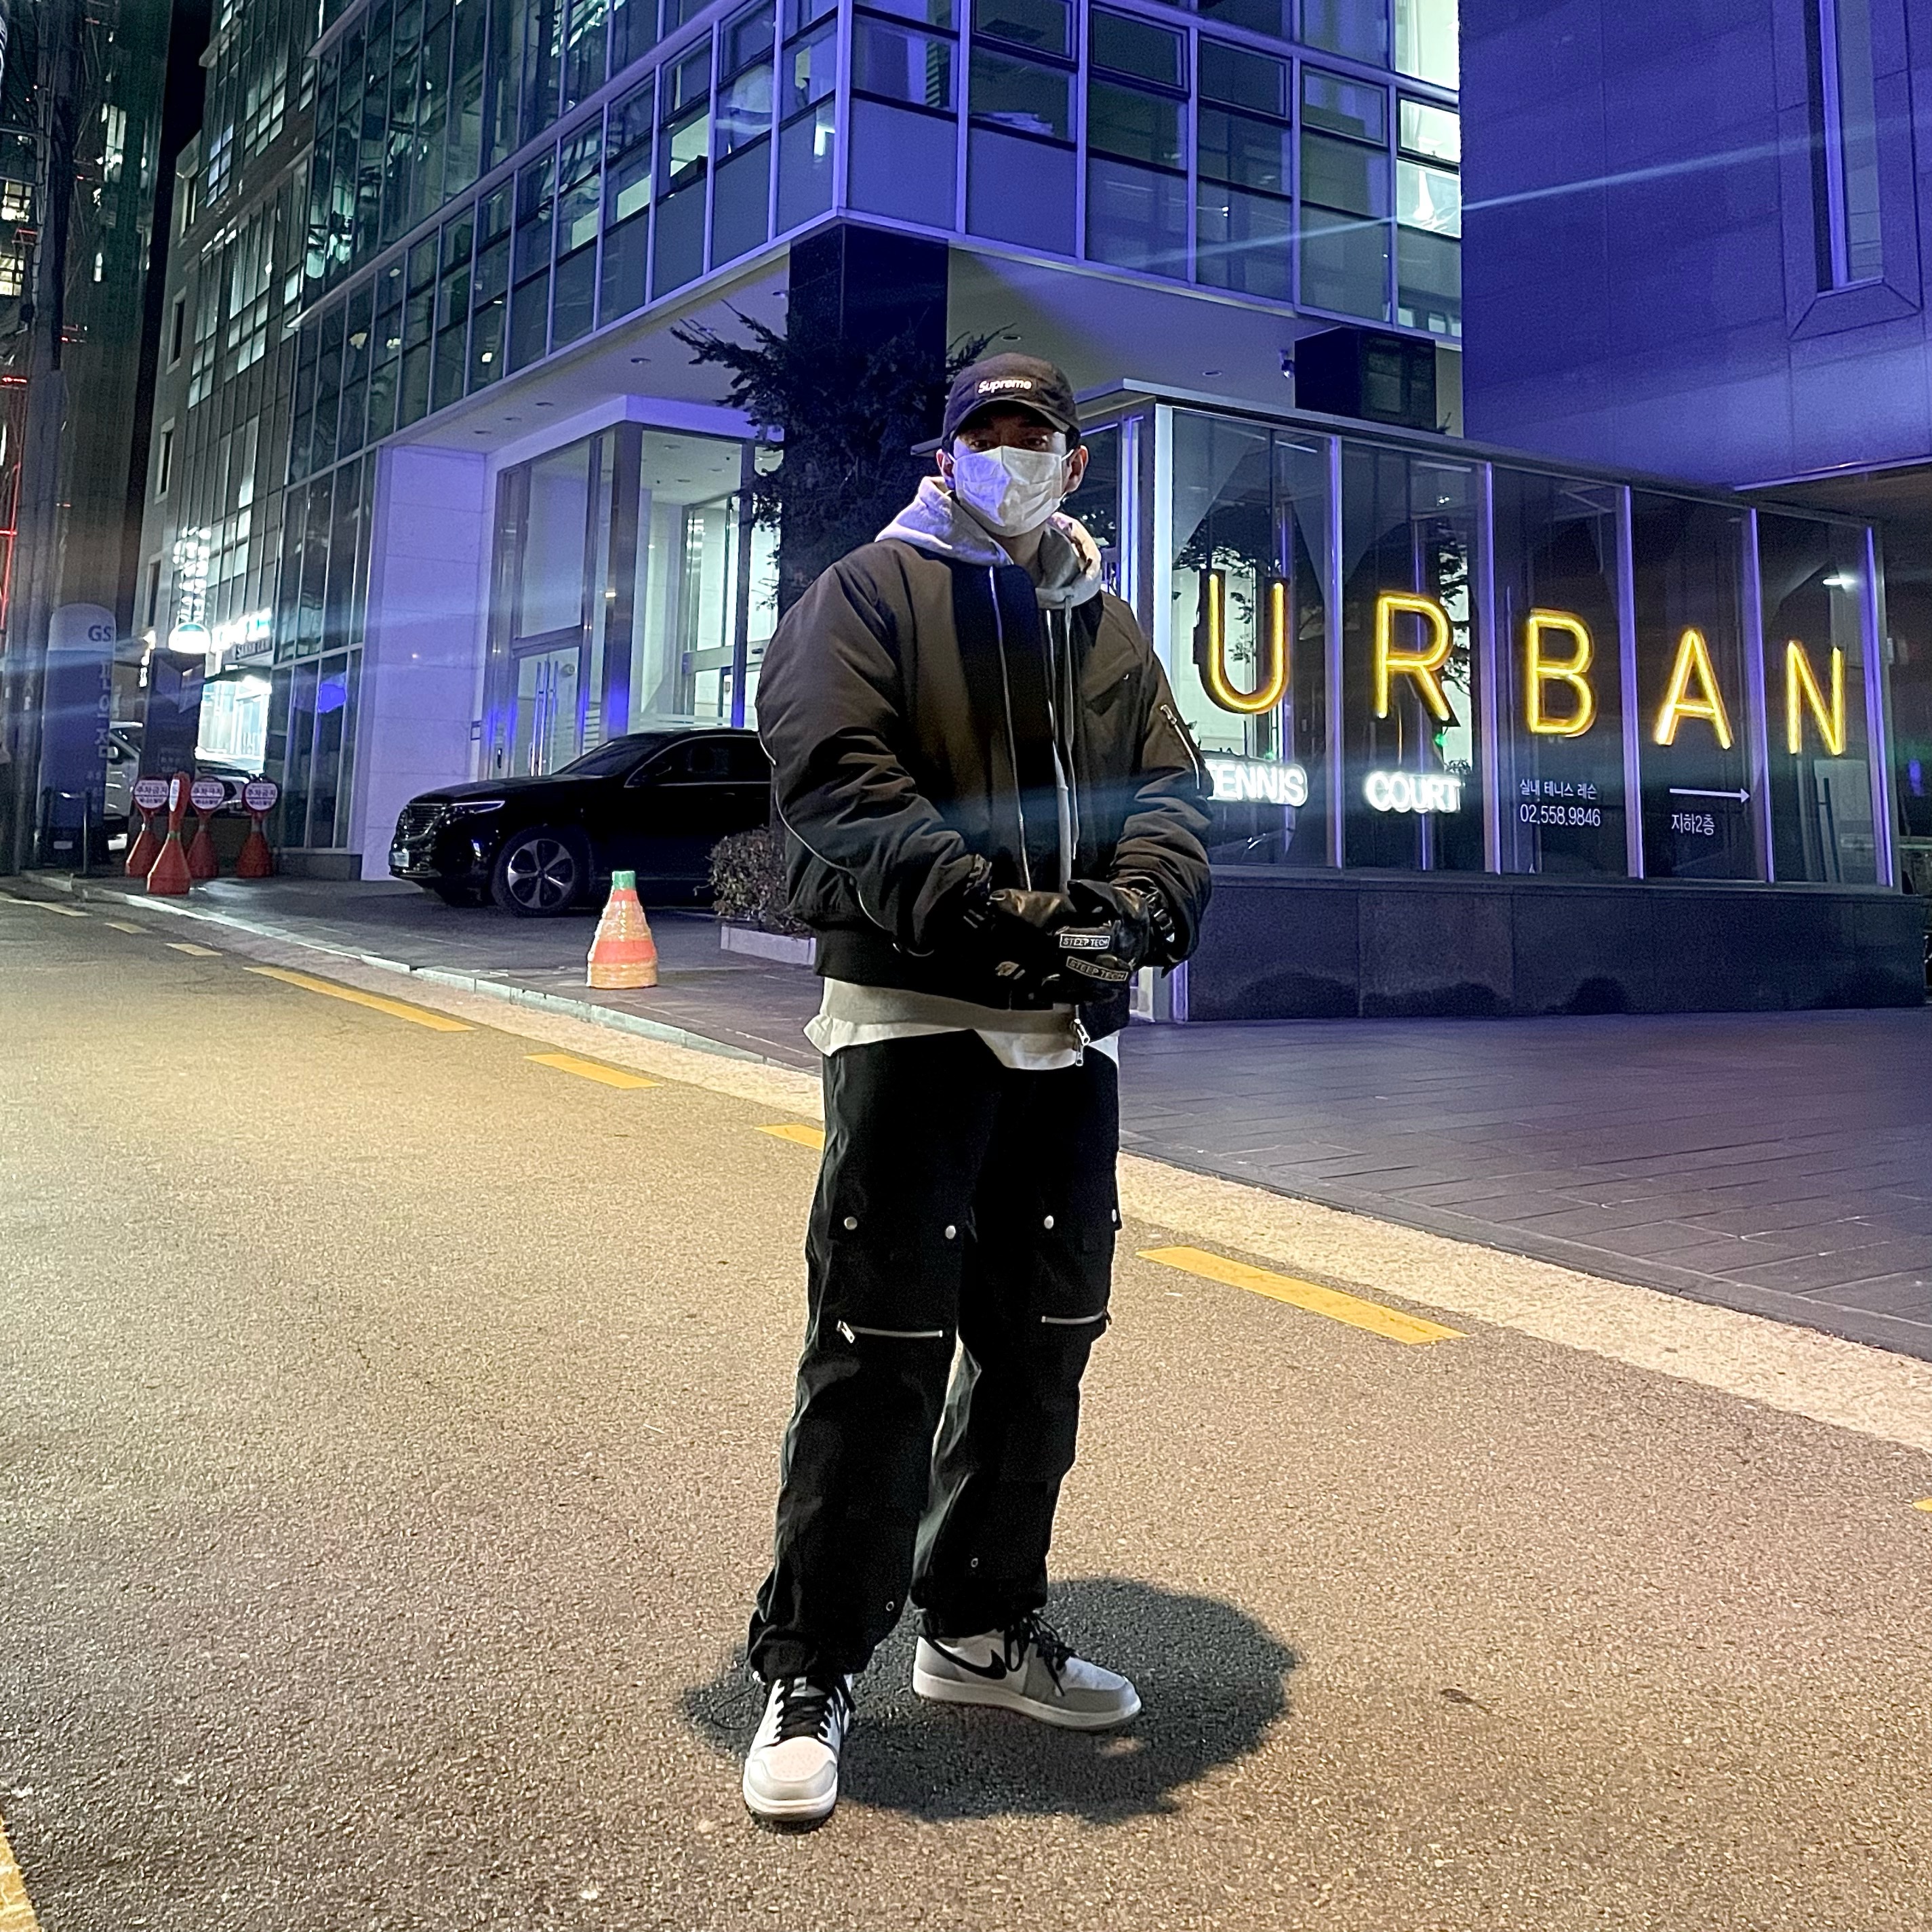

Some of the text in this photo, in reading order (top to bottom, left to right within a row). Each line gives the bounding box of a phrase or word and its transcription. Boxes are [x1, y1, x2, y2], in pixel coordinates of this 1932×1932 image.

[978, 379, 1032, 394] Supreme
[1201, 571, 1845, 755] URBAN
[1365, 770, 1462, 813] COURT
[1519, 779, 1598, 800] 실내 테니스 레슨
[1520, 804, 1601, 826] 02.558.9846
[1671, 813, 1715, 835] 지하2층
[1063, 938, 1108, 946] STEEP TECH
[1069, 959, 1099, 974] STEEP
